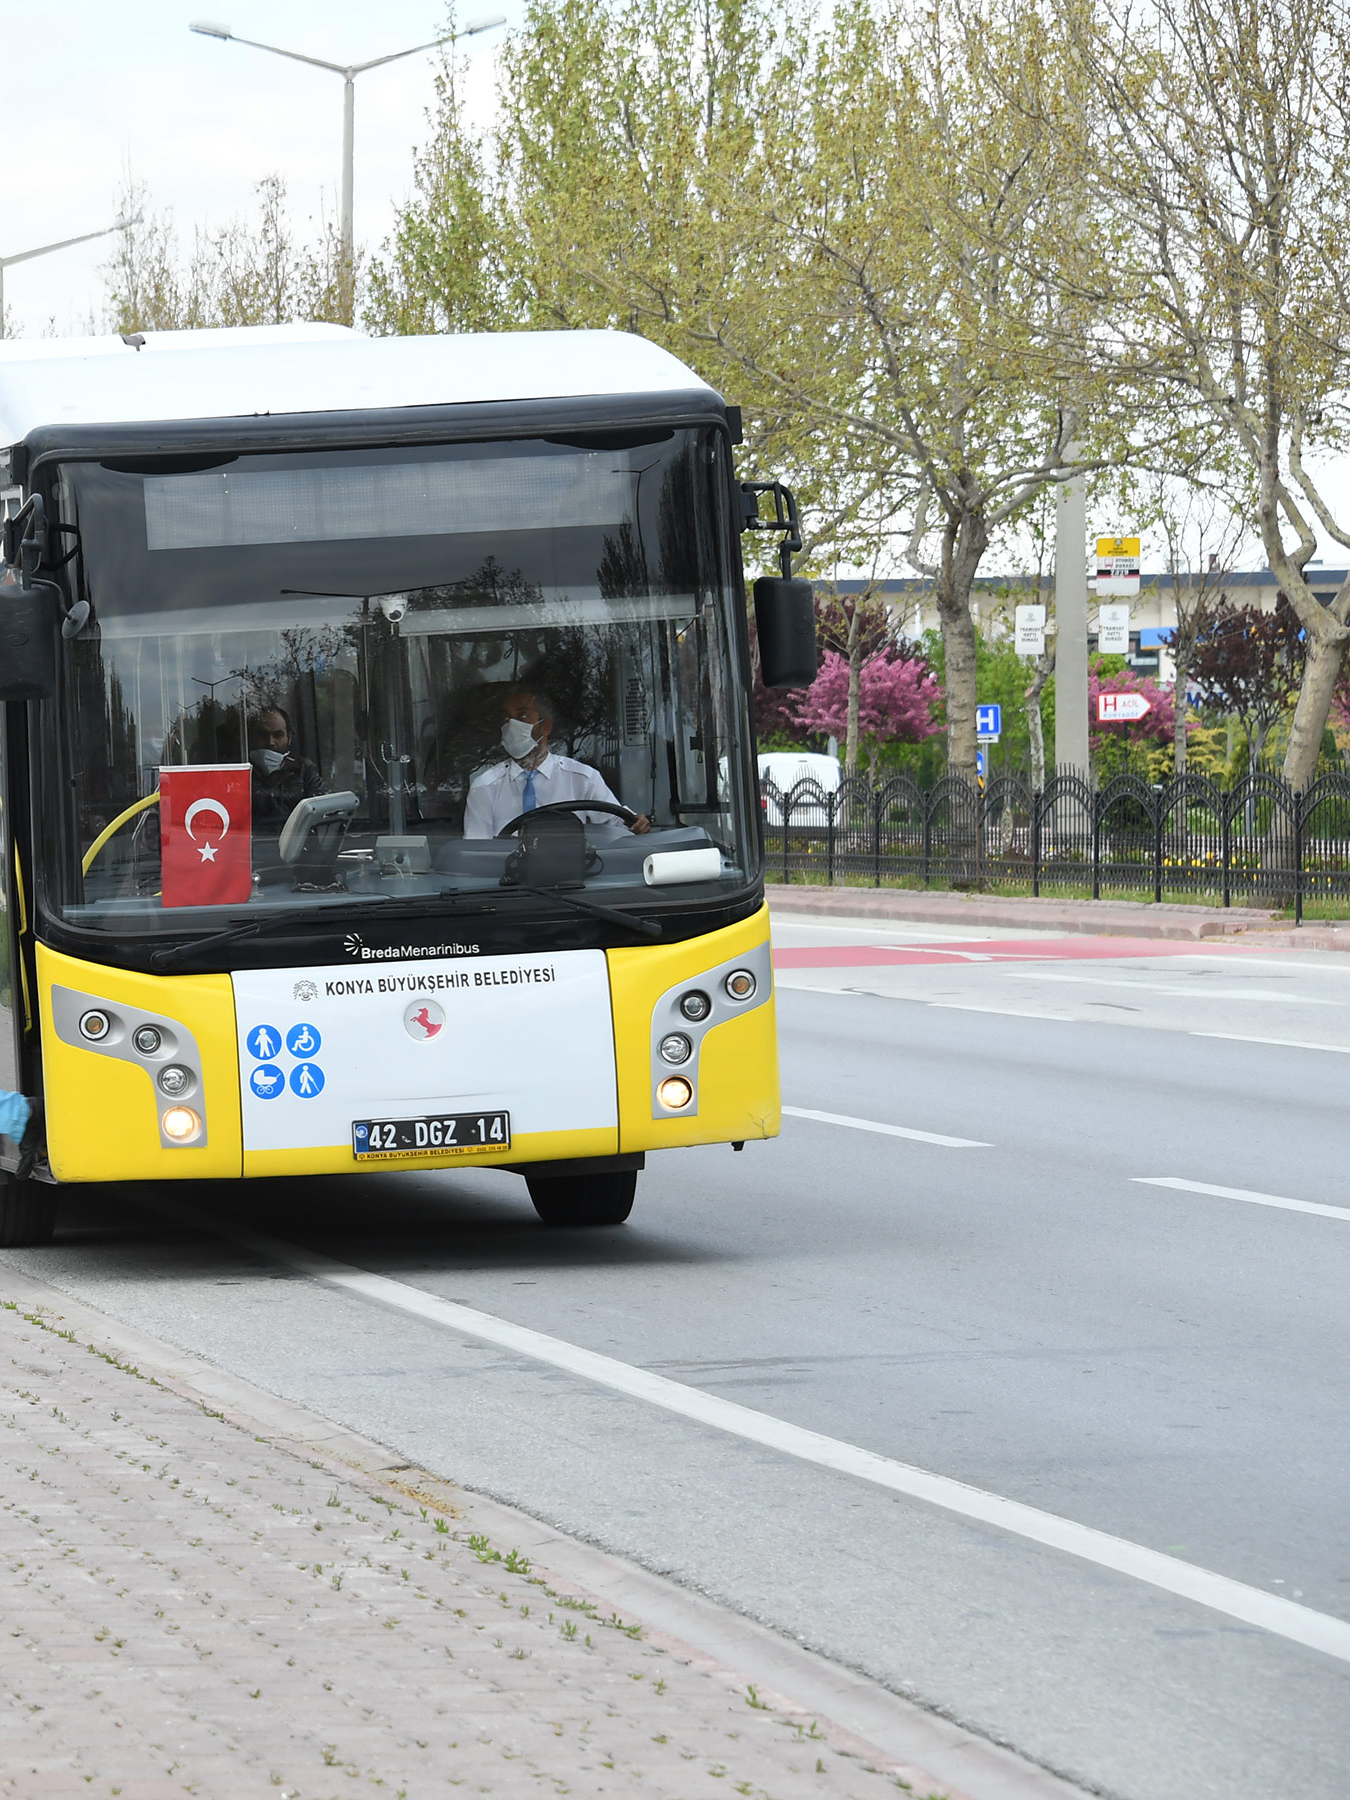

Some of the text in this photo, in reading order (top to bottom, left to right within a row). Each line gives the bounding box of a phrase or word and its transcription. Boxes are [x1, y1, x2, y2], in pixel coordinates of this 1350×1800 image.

[1104, 696, 1116, 712] H
[976, 708, 994, 731] H
[361, 942, 480, 960] BredaMenarinibus
[325, 964, 556, 996] KONYA BÜYÜKŞEHİR BELEDİYESİ
[369, 1117, 504, 1149] 42 DGZ 14
